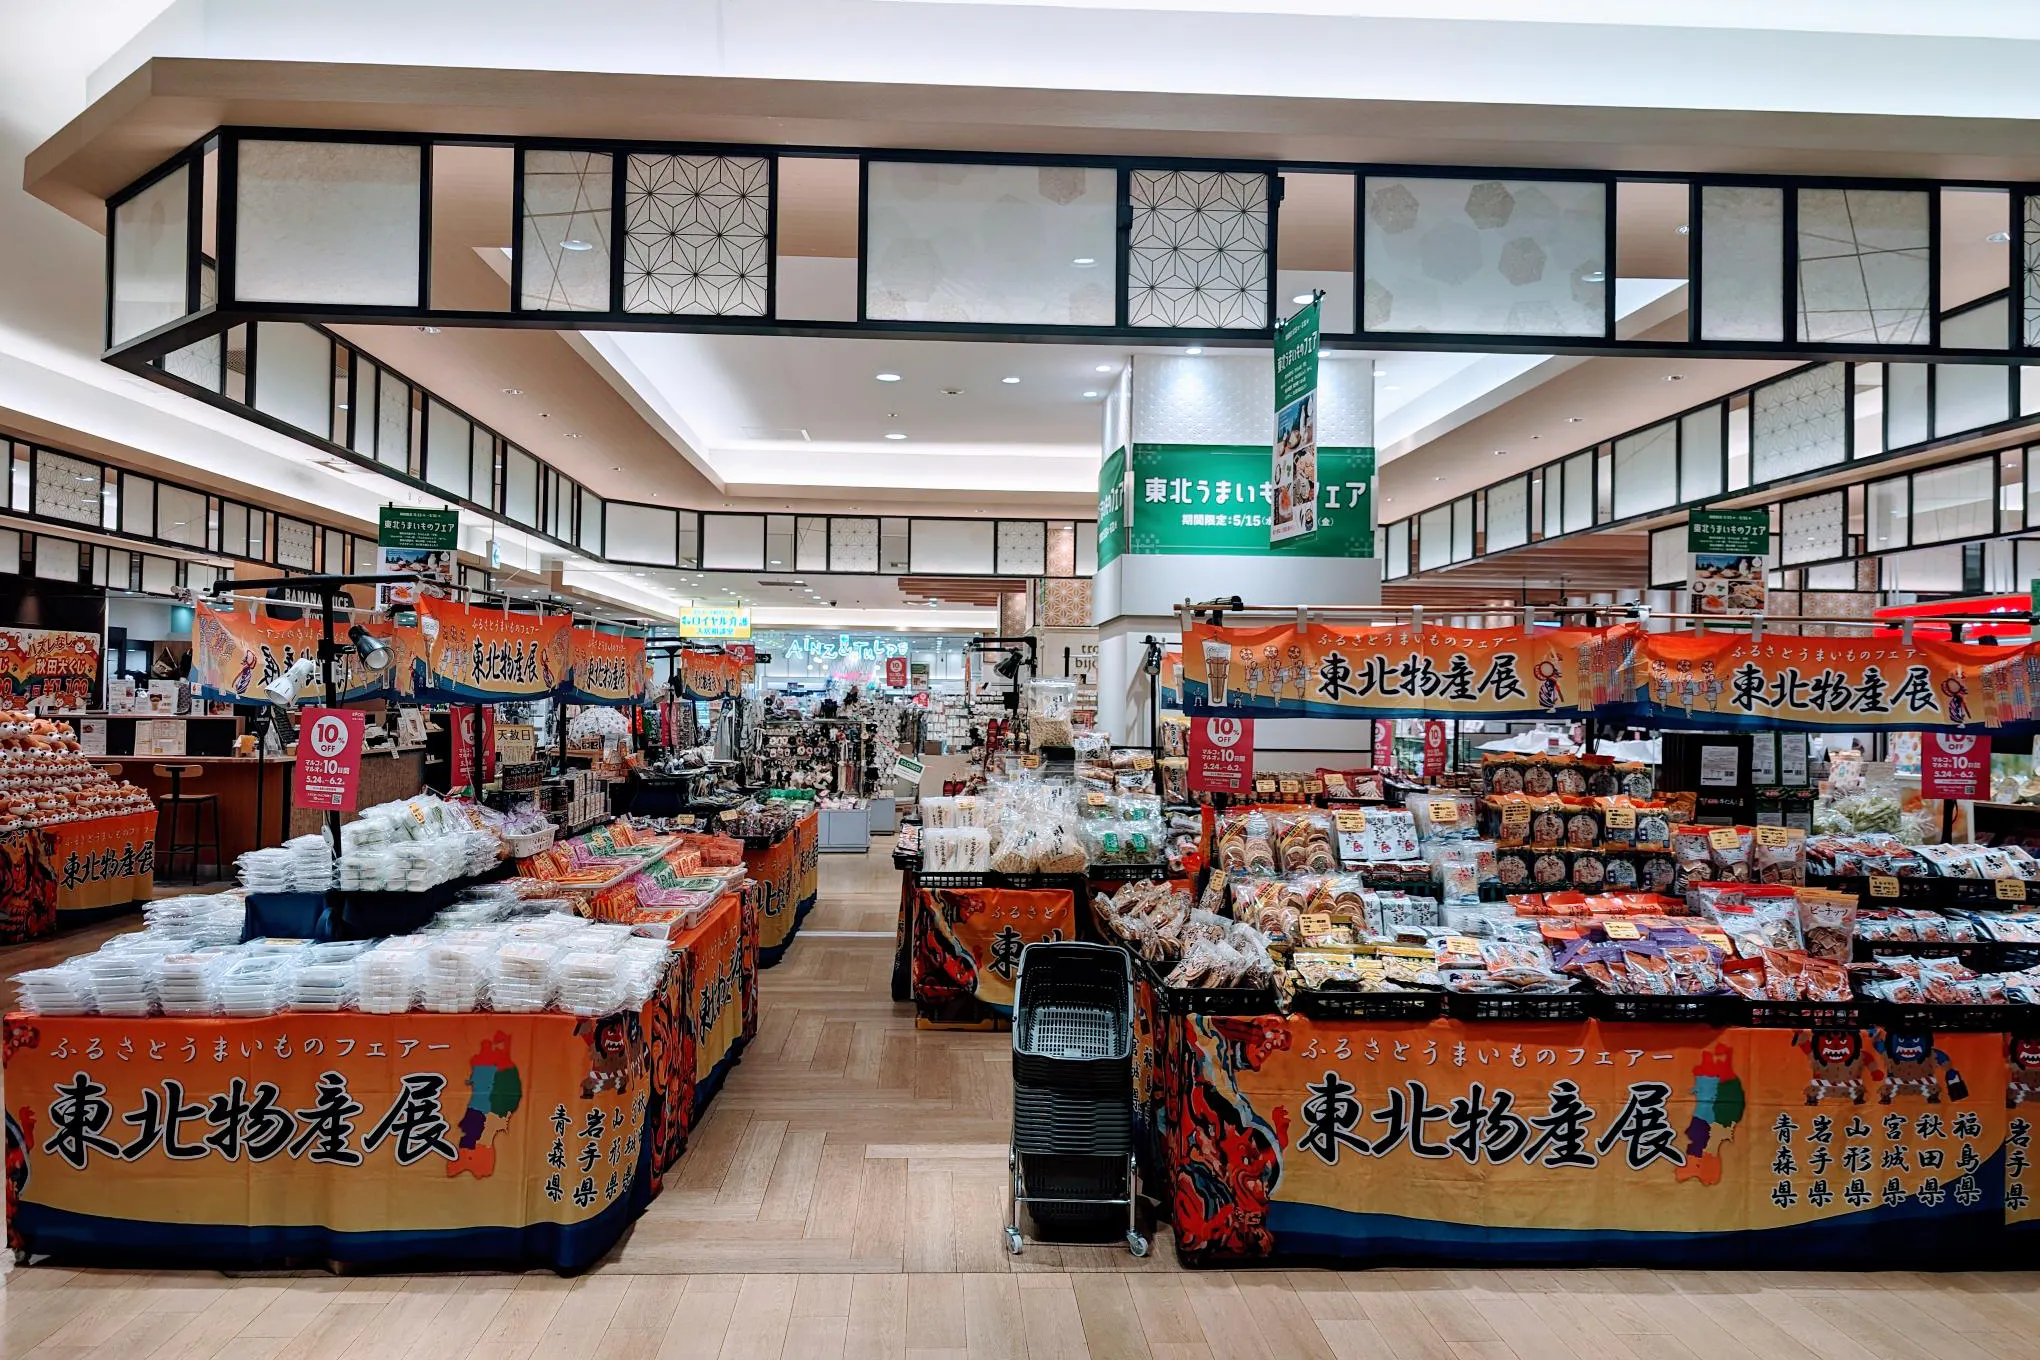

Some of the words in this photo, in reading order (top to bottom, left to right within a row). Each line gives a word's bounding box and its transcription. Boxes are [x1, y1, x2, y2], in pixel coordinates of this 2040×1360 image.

[1145, 477, 1367, 509] 東北うまいもェア
[384, 520, 455, 533] 東北うまいものフェア
[1693, 523, 1767, 536] 東北うまいものフェア
[285, 588, 322, 606] BANANA
[28, 632, 73, 657] ハズレなし
[471, 636, 539, 685] 東北物産展
[1317, 632, 1518, 649] ふるさとうまいものフェアー
[1731, 645, 1927, 662] ふるさとうまいものフェアー
[35, 657, 87, 675] 秋田犬くじ
[586, 655, 626, 691] 東北物産展
[1317, 651, 1527, 701] 東北物産展
[1730, 664, 1941, 714] 東北物産展
[321, 745, 336, 753] OFF
[991, 903, 1069, 920] ふるさとう
[50, 1034, 452, 1063] ふるさとうまいものフェアー
[1300, 1036, 1676, 1069] ふるさとうまいものフェアー
[44, 1070, 460, 1170] 東北物産展
[1296, 1069, 1688, 1171] 東北物産展
[545, 1104, 572, 1203] 青森県
[572, 1108, 607, 1208] 岩手県
[605, 1107, 625, 1200] 山形県
[1771, 1112, 1799, 1209] 青森県
[1806, 1114, 1834, 1208] 岩手県
[1843, 1116, 1872, 1208] 山形県
[1880, 1113, 1909, 1208] 宮城県
[1915, 1112, 1947, 1208] 秋田県
[1952, 1111, 1982, 1206] 福島県
[2004, 1117, 2032, 1212] 岩手県
